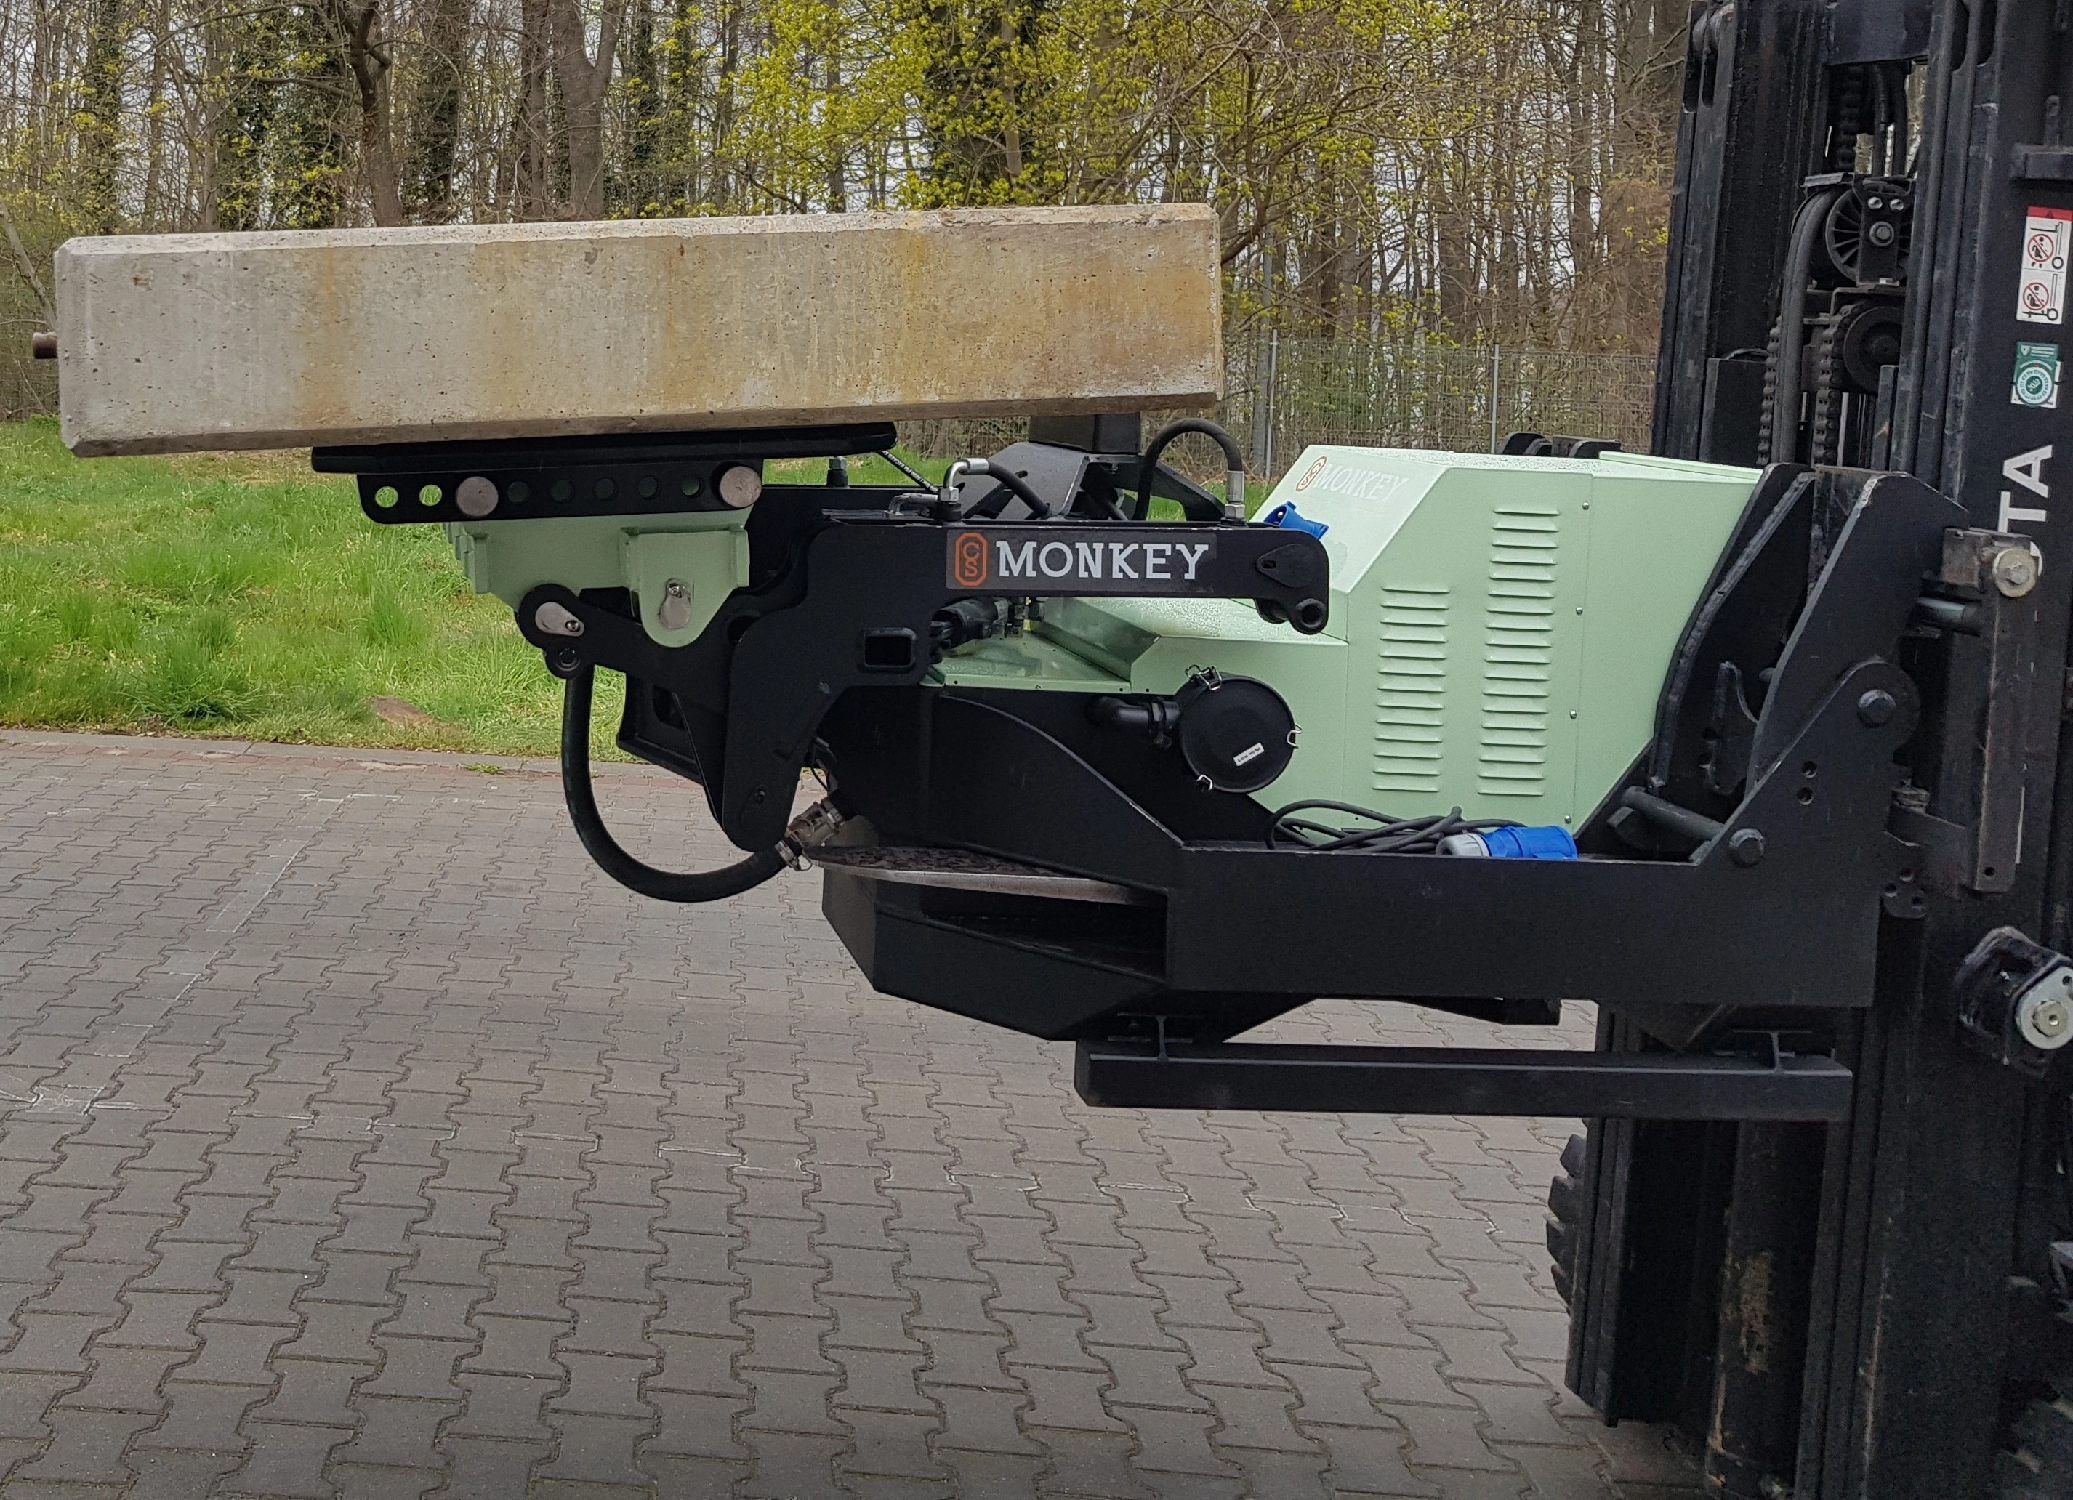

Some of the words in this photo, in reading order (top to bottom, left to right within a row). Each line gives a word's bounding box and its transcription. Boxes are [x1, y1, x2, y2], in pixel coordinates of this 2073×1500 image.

[1312, 463, 1410, 501] MONKEY
[1998, 444, 2053, 577] TA
[996, 540, 1209, 580] MONKEY
